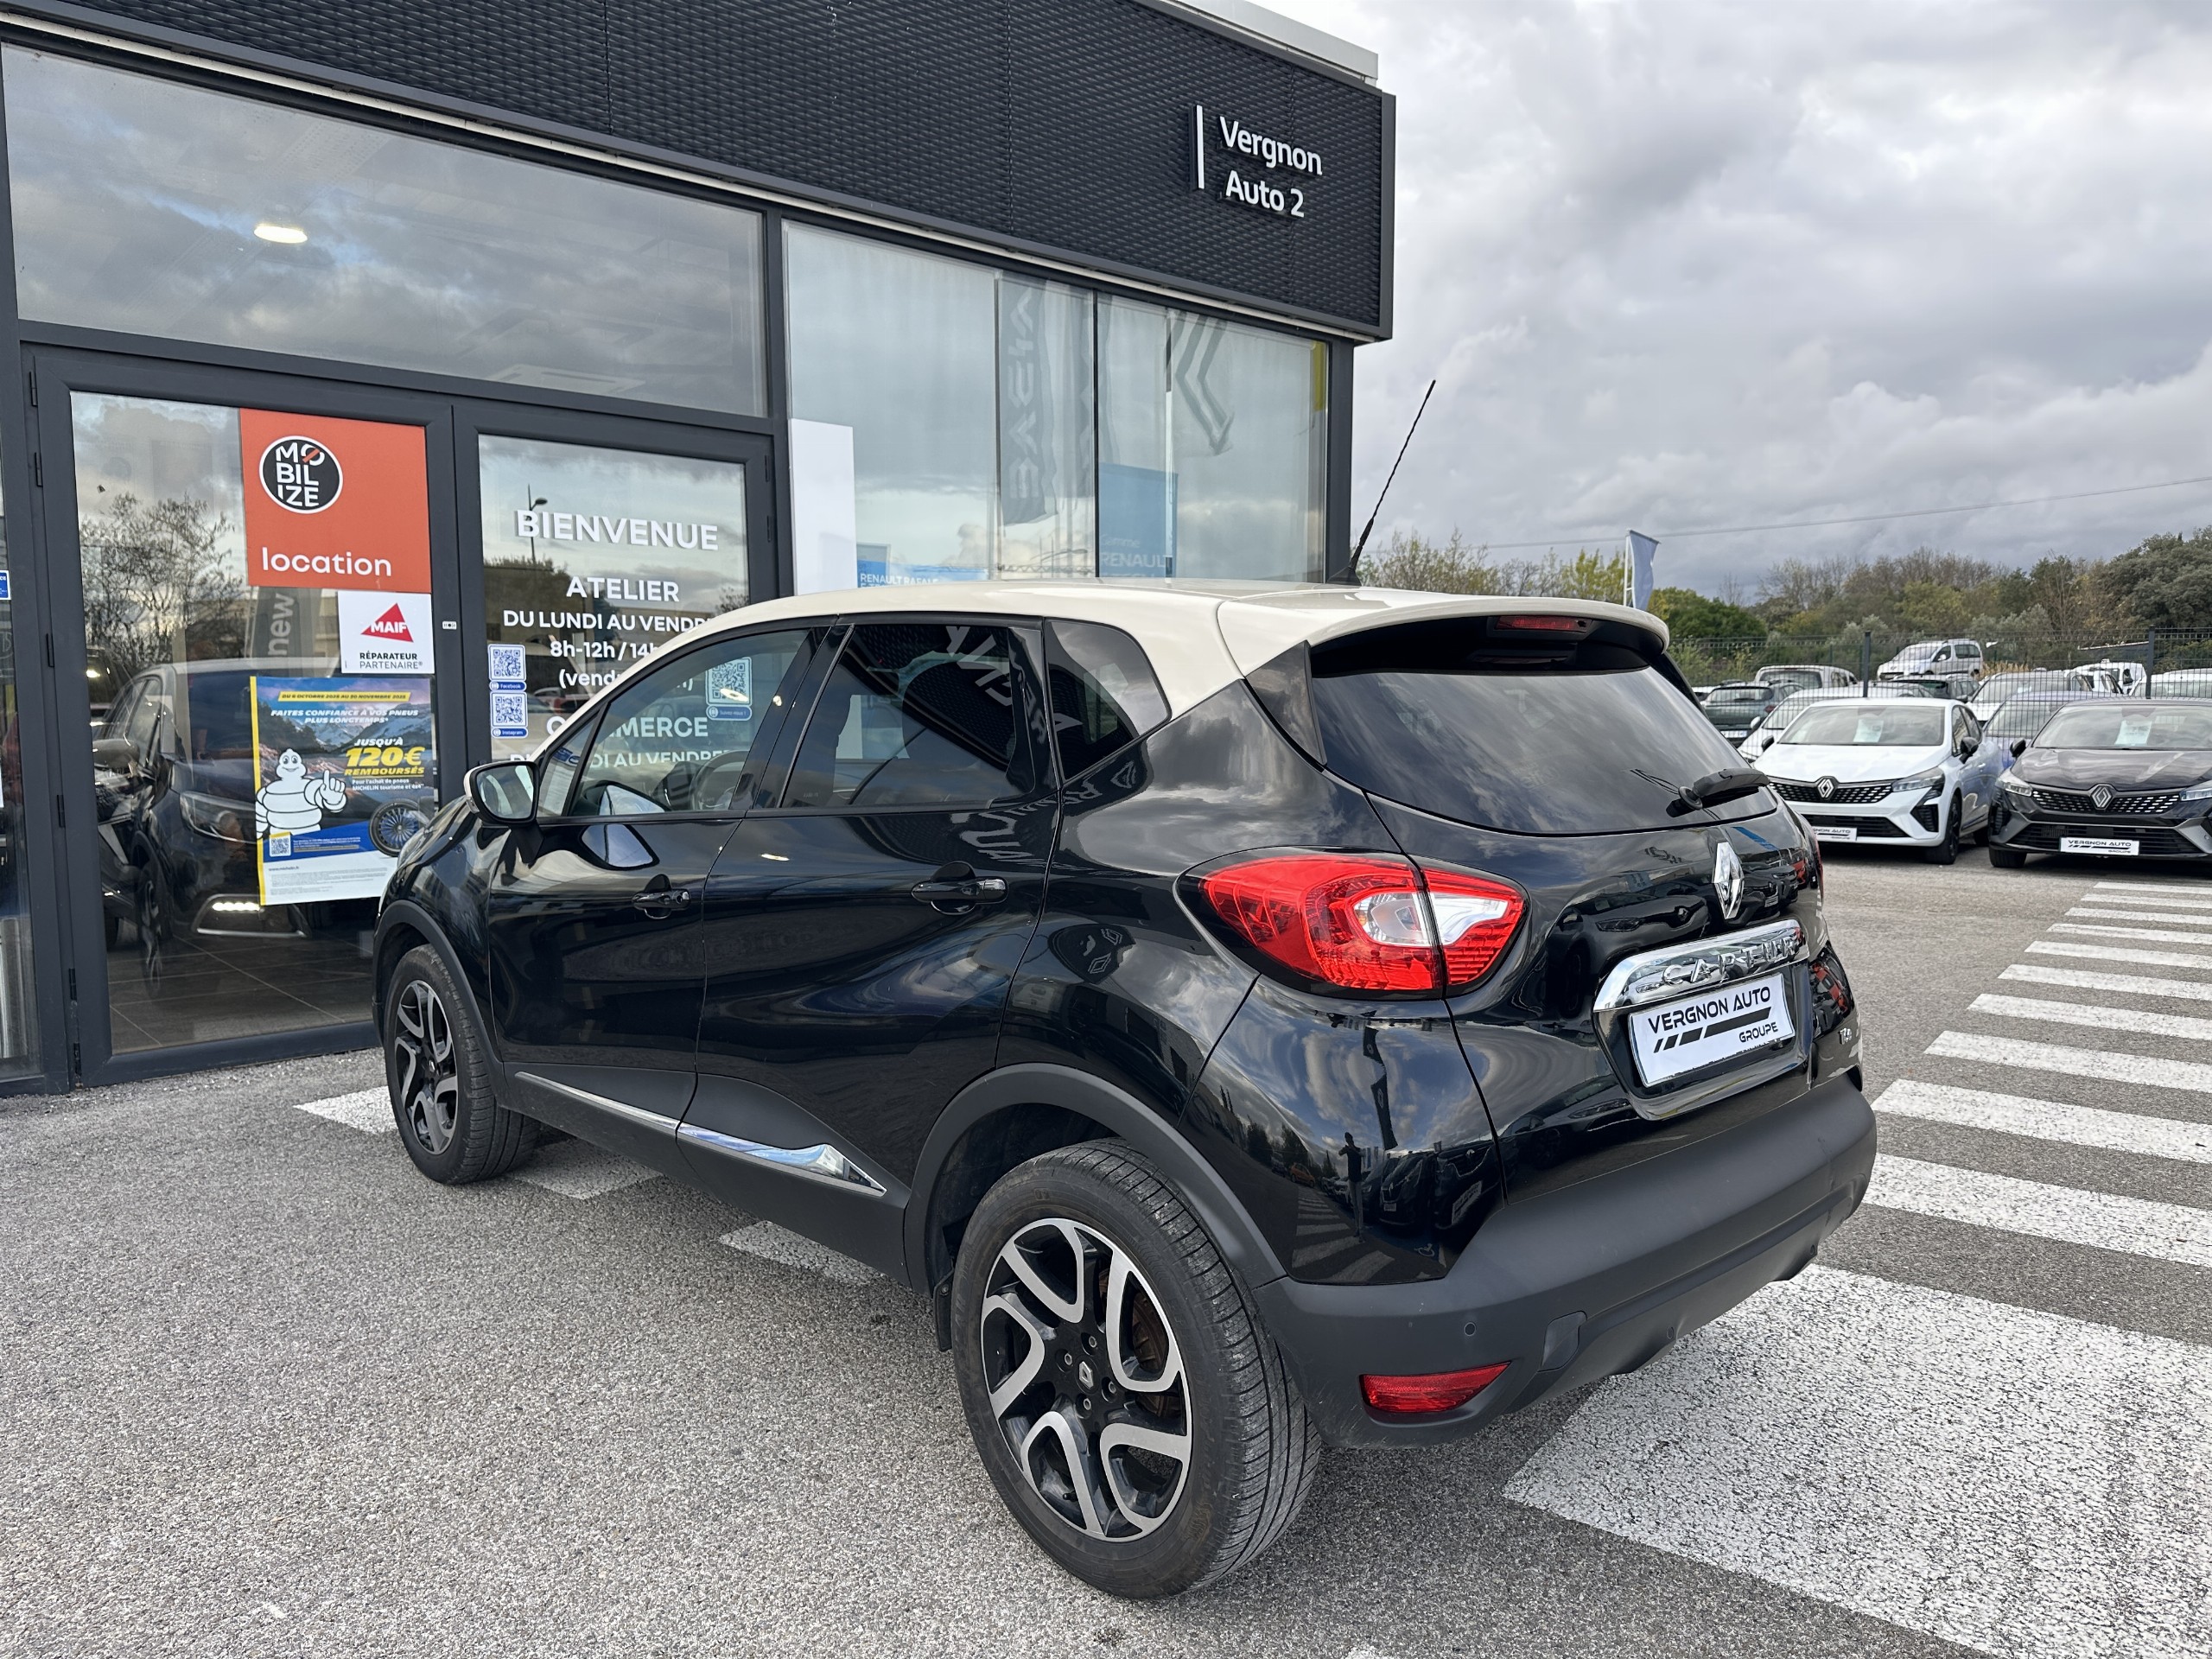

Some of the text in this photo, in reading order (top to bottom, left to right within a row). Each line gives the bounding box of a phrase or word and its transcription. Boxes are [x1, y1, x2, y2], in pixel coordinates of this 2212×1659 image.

[1219, 116, 1323, 175] Vergnon
[1225, 169, 1305, 218] Auto 2
[517, 509, 719, 551] BIENVENUE
[262, 546, 392, 577] location
[566, 576, 679, 602] ATELIER
[860, 573, 902, 585] RENAULT
[268, 593, 296, 656] new
[370, 621, 408, 633] MAIF
[503, 610, 714, 632] DU LUNDI AU VENDR
[359, 651, 417, 660] RÉPARATEUR
[550, 639, 615, 658] 8h-12h
[559, 669, 621, 689] (vend
[546, 715, 709, 738] CMERCE
[346, 746, 426, 767] 120€
[613, 752, 642, 768] AU
[345, 766, 425, 776] REMBOURSÉS
[1662, 936, 1797, 986] CAPTUR
[1648, 986, 1771, 1034] VERGNON AUTO
[1739, 1021, 1778, 1043] GROUPE
